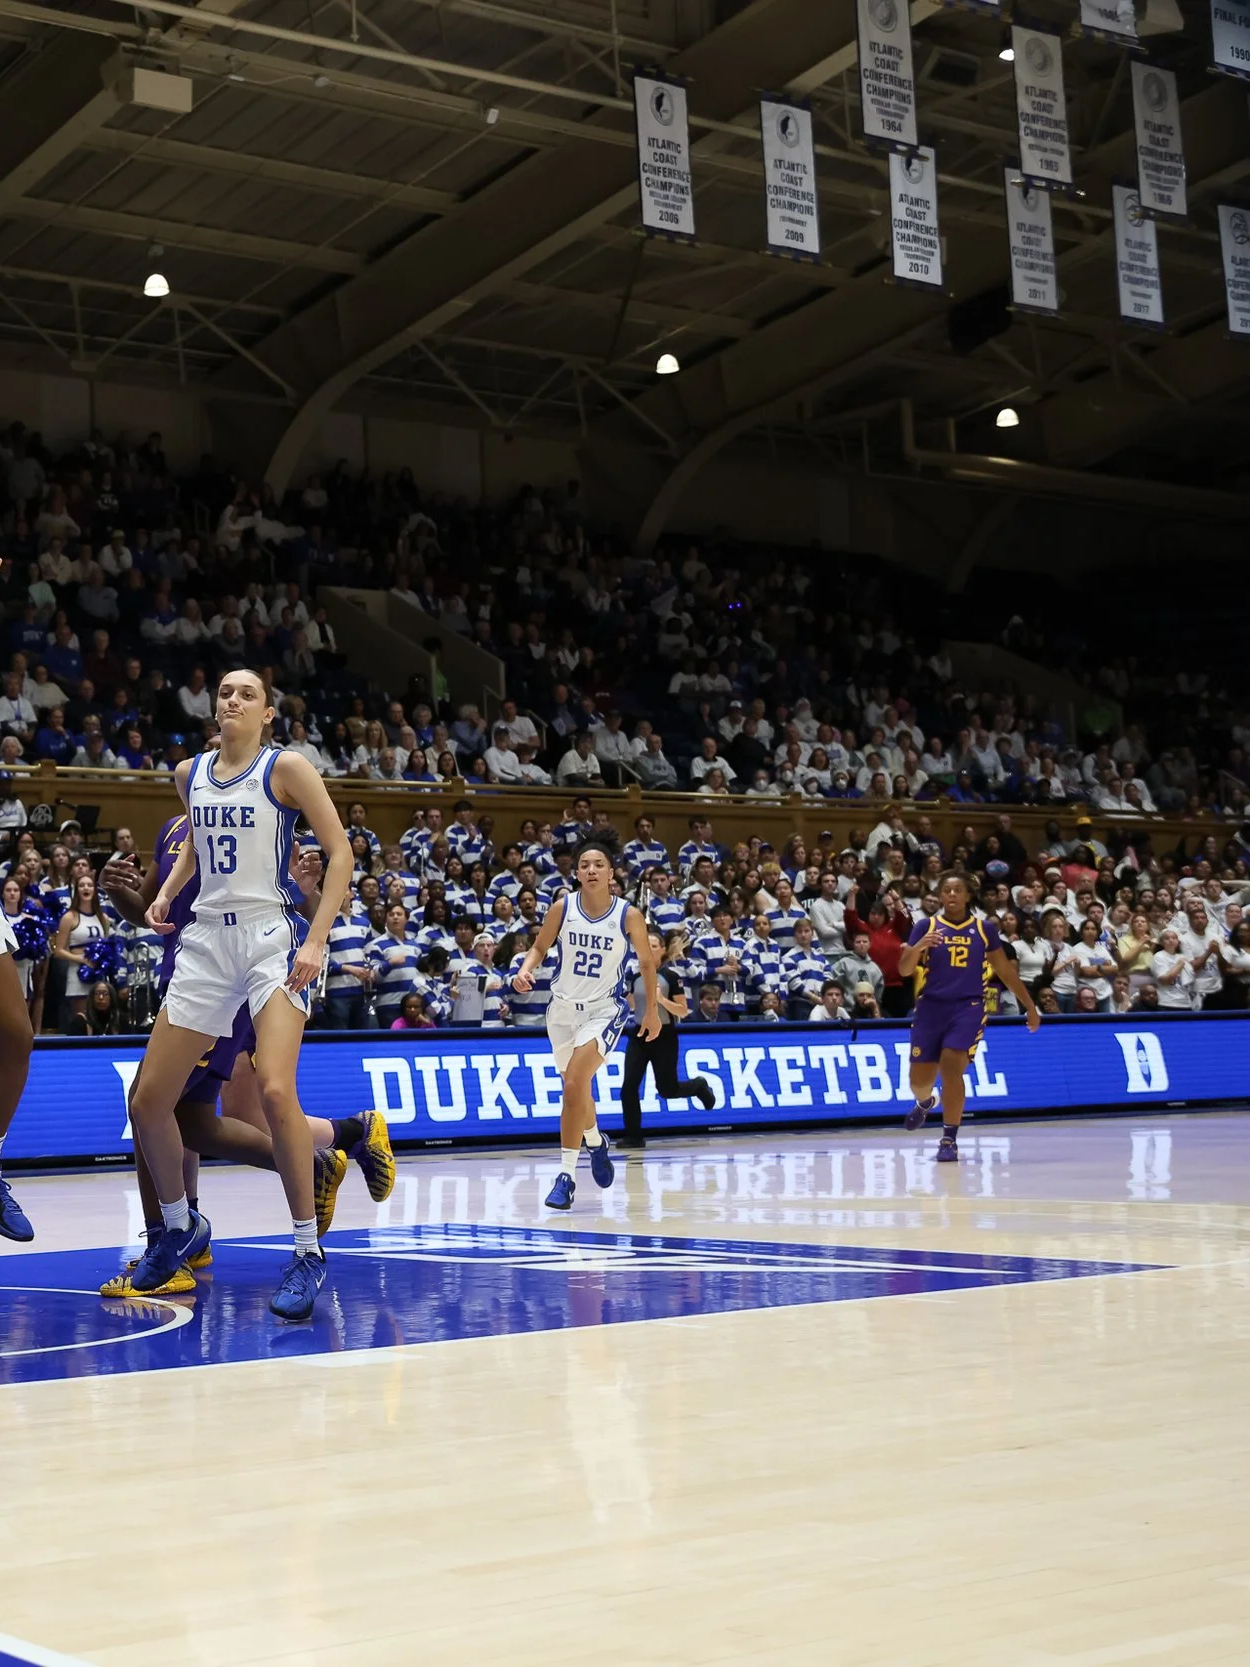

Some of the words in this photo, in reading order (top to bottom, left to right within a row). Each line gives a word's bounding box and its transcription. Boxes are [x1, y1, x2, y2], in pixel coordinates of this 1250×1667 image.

[869, 40, 903, 60] ATLANTIC
[874, 57, 899, 72] COAST
[863, 68, 914, 91] CONFERENCE
[866, 83, 911, 105] CHAMPIONS
[1024, 85, 1058, 102] ATLANTIC
[881, 118, 902, 133] 1964
[1020, 111, 1066, 131] CONFERENCE
[1023, 126, 1066, 145] CHAMPIONS
[648, 137, 681, 154] ATLANTIC
[653, 152, 678, 166] COAST
[773, 159, 808, 175] ATLANTIC
[642, 162, 690, 184] CONFERENCE
[780, 172, 803, 187] COAST
[645, 177, 690, 196] CHAMPIONS
[767, 184, 815, 203] CONFERENCE
[769, 198, 814, 217] CHAMPIONS
[899, 193, 930, 210] ATLANTIC
[659, 210, 679, 224] 2006
[905, 207, 926, 221] COAST
[785, 229, 804, 244] 2009
[893, 218, 938, 237] CONFERENCE
[896, 232, 937, 250] CHAMPIONS
[909, 262, 929, 275] 2010
[193, 806, 255, 828] DUKE
[206, 834, 237, 875] 13
[569, 931, 614, 951] DUKE
[944, 935, 971, 945] LSU
[573, 950, 603, 978] 22
[947, 946, 969, 968] 12
[361, 1052, 564, 1125] DUKE
